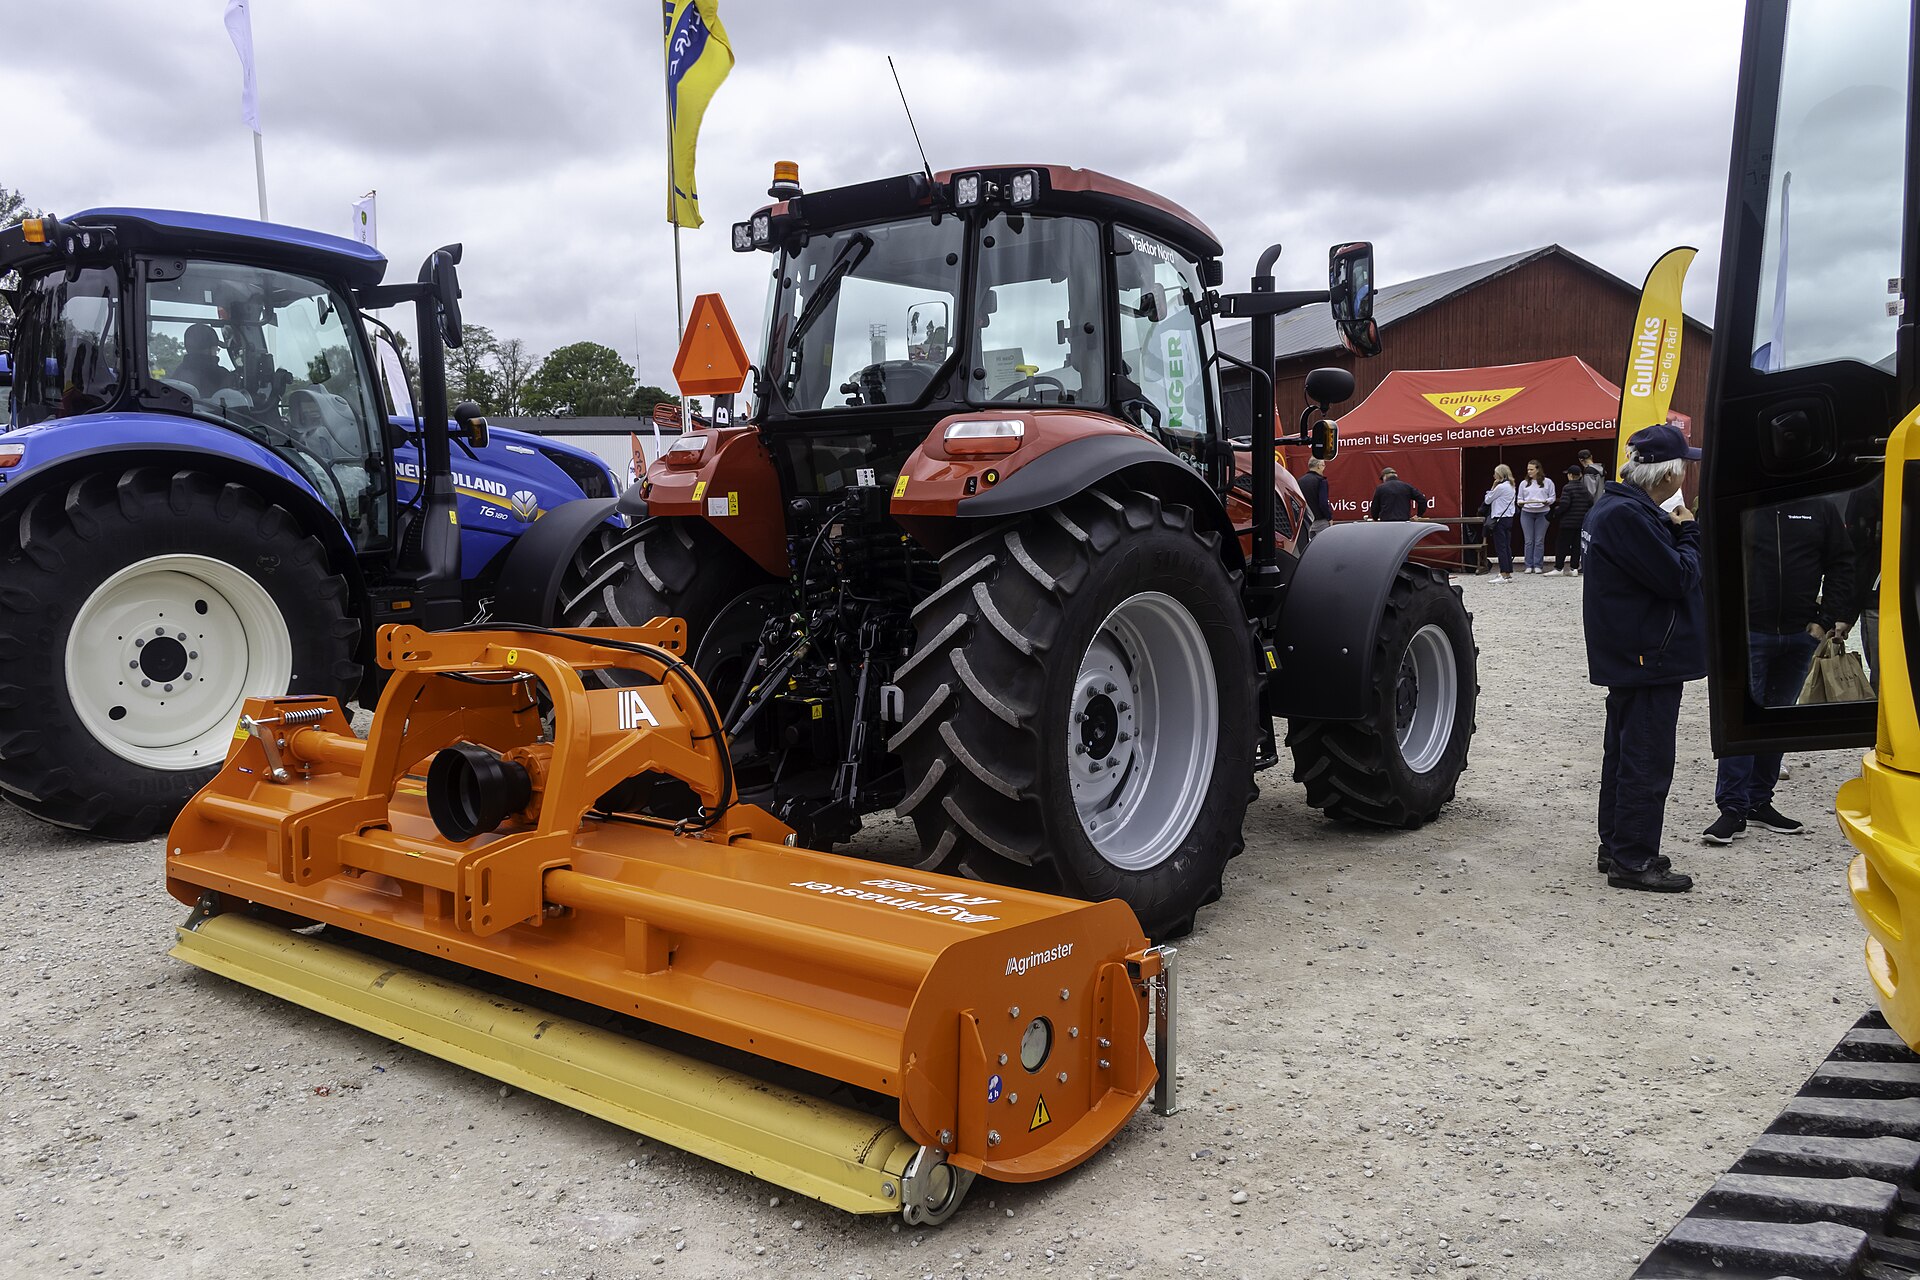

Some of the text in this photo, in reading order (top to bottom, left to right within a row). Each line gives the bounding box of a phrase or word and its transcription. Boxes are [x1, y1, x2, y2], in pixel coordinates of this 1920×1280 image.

[1129, 234, 1175, 264] Traktor Nord
[1630, 317, 1660, 397] Gullviks
[1658, 327, 1678, 392] Ger dig råd!
[1168, 335, 1186, 428] NGER
[1439, 395, 1502, 405] Gullviks
[1338, 418, 1616, 447] mmen till Sveriges ledande växtskyddsspecial
[451, 471, 507, 497] OLLAND
[1328, 499, 1357, 511] viks
